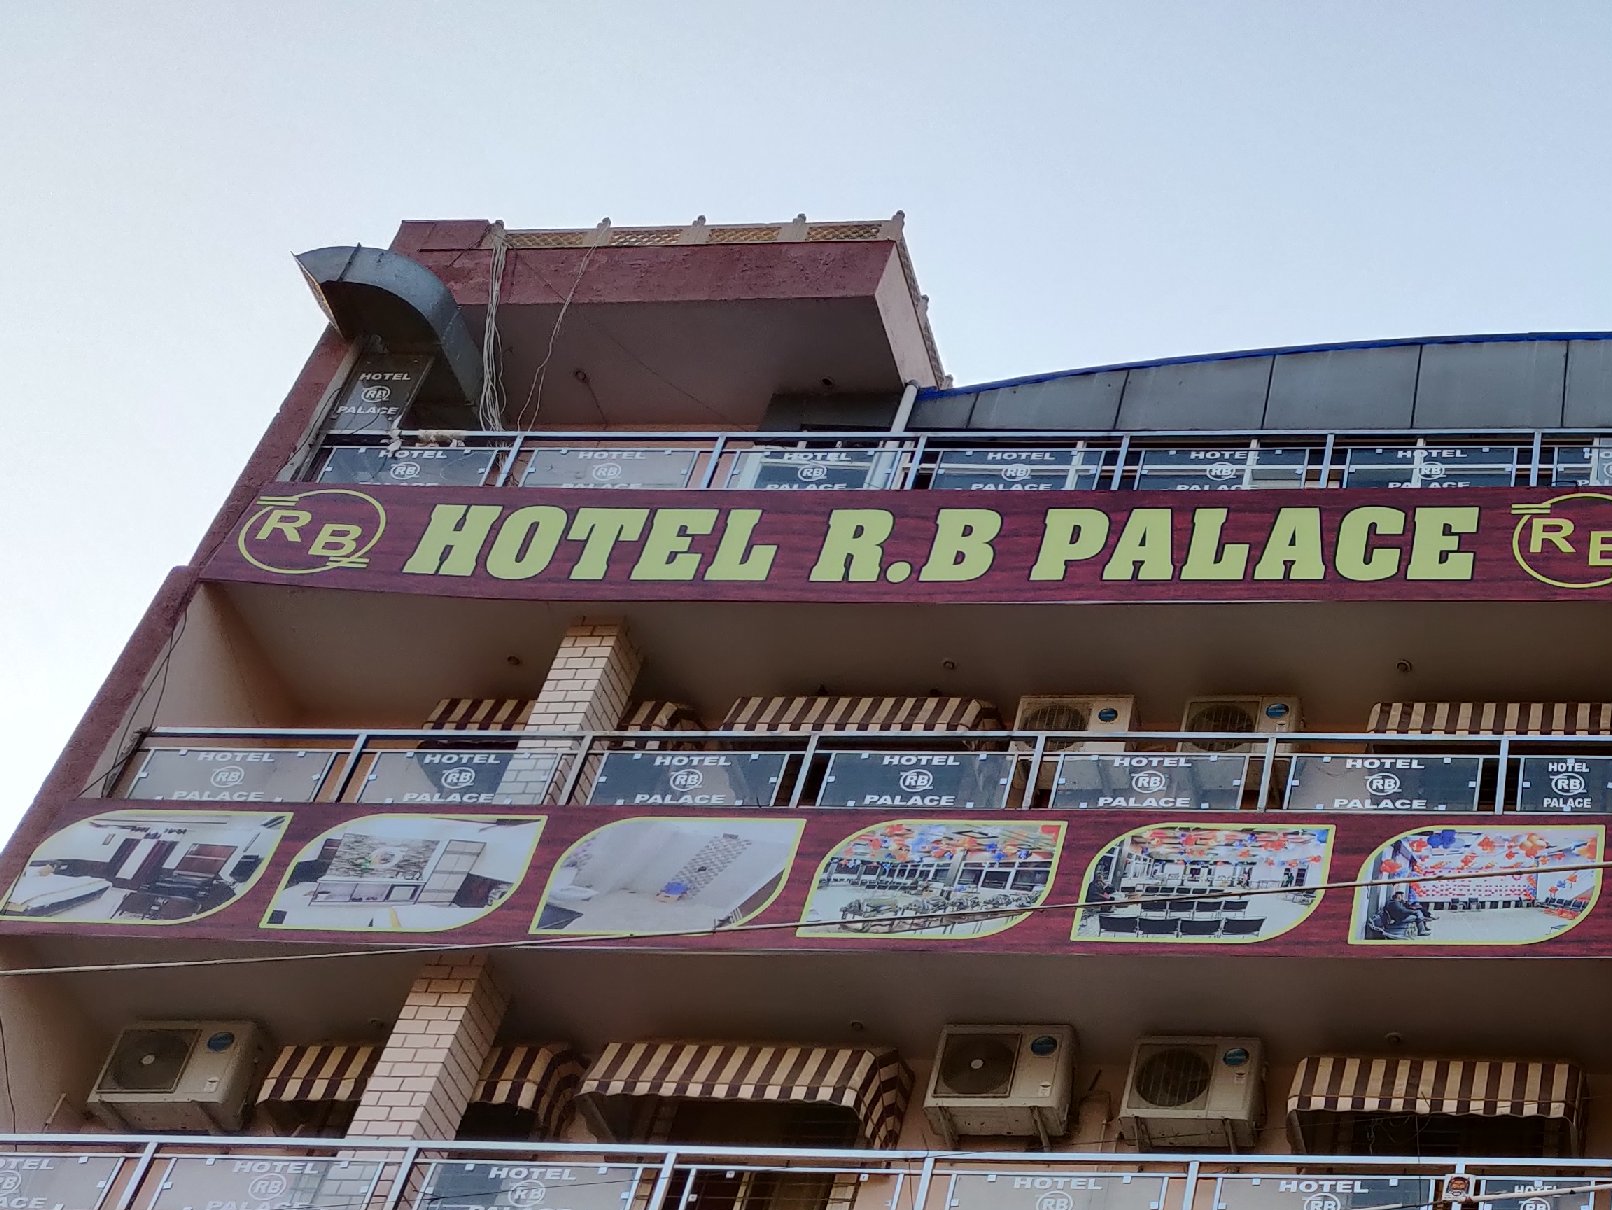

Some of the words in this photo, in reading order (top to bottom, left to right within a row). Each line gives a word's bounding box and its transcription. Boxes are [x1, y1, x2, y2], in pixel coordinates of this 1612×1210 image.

[359, 373, 411, 381] HOTEL
[337, 405, 400, 415] PALACE
[578, 451, 646, 460] HOTEL
[783, 452, 852, 460] HOTEL
[987, 451, 1055, 460] HOTEL
[392, 465, 419, 475] RB
[597, 467, 618, 477] RB
[802, 468, 823, 477] RB
[1007, 467, 1028, 477] RB
[1211, 468, 1232, 476] RB
[1420, 466, 1441, 475] RB
[256, 509, 363, 557] RB
[401, 503, 780, 581] HOTEL
[808, 507, 1003, 584] R.B
[1028, 505, 1481, 582] PALACE
[198, 752, 275, 762] HOTEL
[423, 754, 501, 764] HOTEL
[653, 755, 732, 766] HOTEL
[882, 756, 960, 766] HOTEL
[1113, 757, 1193, 768] HOTEL
[1345, 758, 1425, 769] HOTEL
[1548, 762, 1590, 773] HOTEL
[215, 770, 240, 784] RB
[445, 771, 471, 784] RB
[675, 772, 700, 786] RB
[906, 774, 931, 787] RB
[1138, 775, 1163, 788] RB
[1372, 778, 1397, 791] RB
[1556, 777, 1581, 791] RB
[172, 790, 265, 801] PALACE
[402, 792, 496, 803] PALACE
[634, 794, 726, 805] PALACE
[863, 795, 956, 806] PALACE
[1098, 797, 1190, 808] PALACE
[1333, 799, 1427, 810] PALACE
[1543, 798, 1592, 809] PALACE
[231, 1161, 320, 1174] HOTEL
[487, 1167, 577, 1181] HOTEL
[255, 1180, 283, 1195] RB
[1013, 1177, 1104, 1190] HOTEL
[1278, 1180, 1370, 1194] HOTEL
